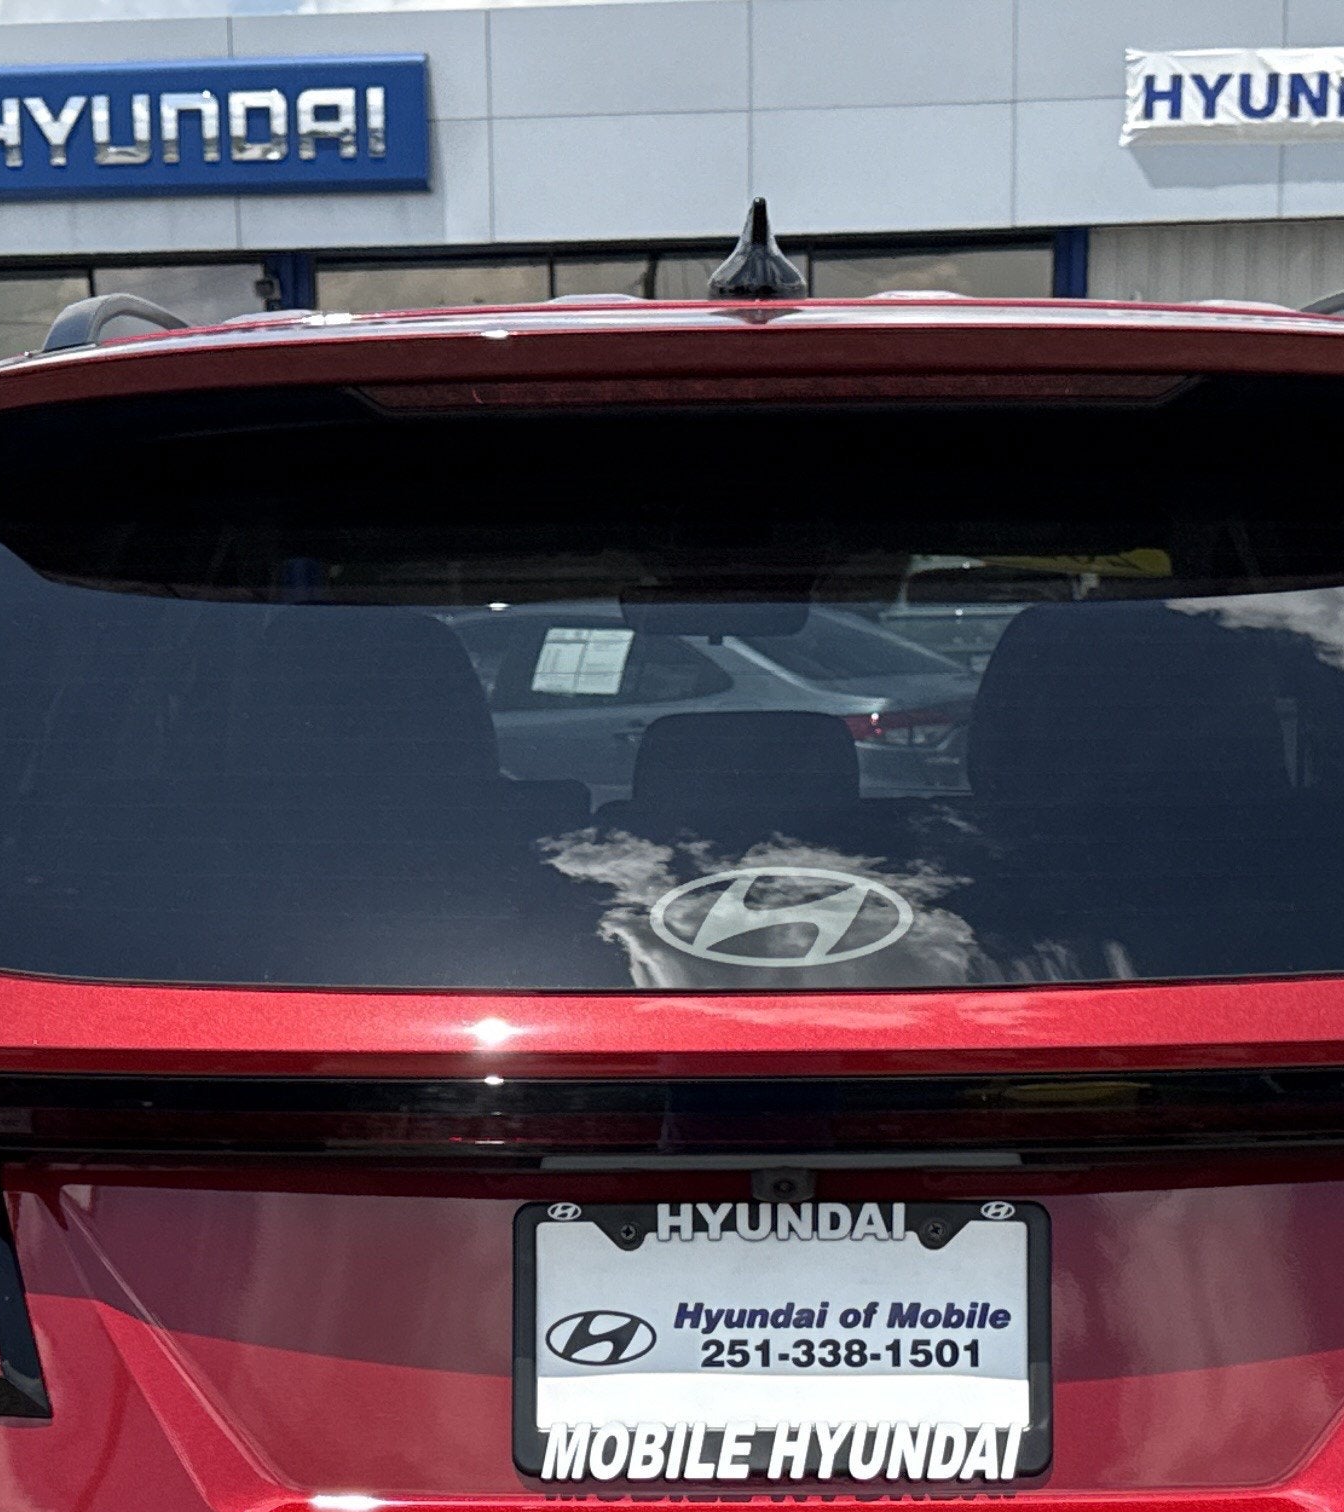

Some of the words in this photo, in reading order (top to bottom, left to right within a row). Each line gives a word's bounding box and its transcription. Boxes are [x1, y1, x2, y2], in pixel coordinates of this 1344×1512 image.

[657, 1202, 907, 1242] HYUNDAI
[673, 1301, 827, 1333] Hyundai
[839, 1302, 879, 1329] of
[887, 1302, 1012, 1330] Mobile
[700, 1338, 981, 1369] 251-338-1501
[540, 1422, 758, 1481] MOBILE
[767, 1422, 1023, 1481] HYUNDAI
